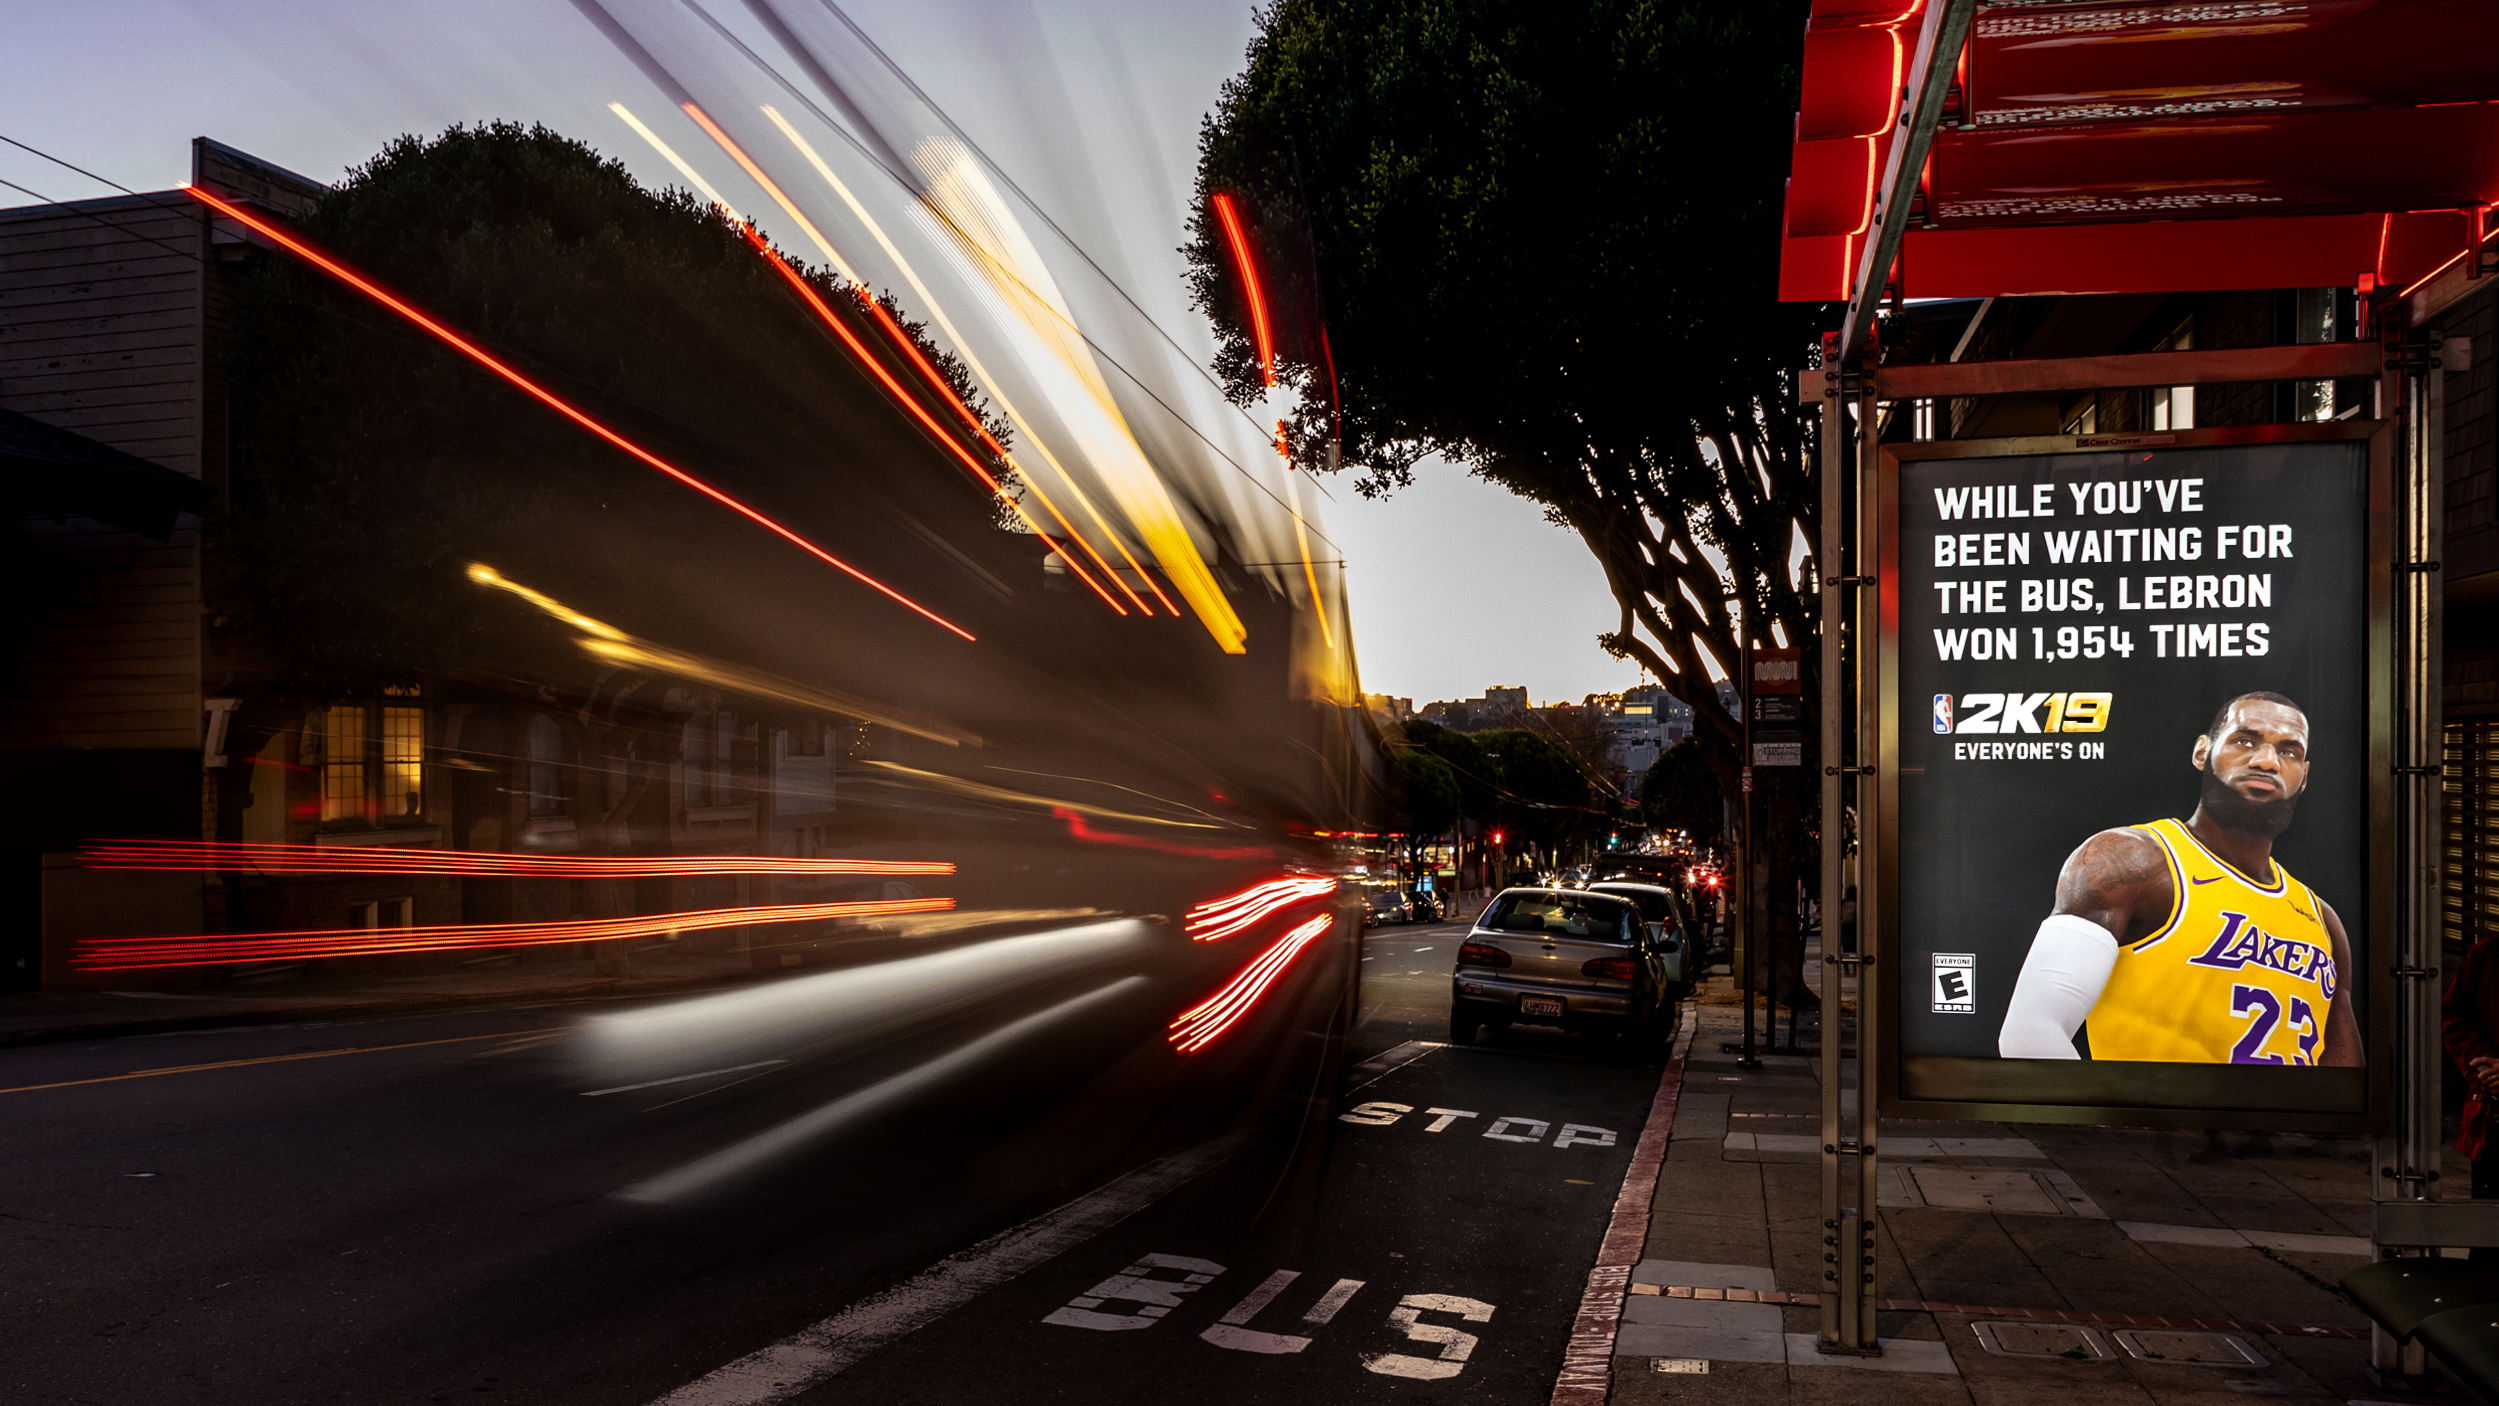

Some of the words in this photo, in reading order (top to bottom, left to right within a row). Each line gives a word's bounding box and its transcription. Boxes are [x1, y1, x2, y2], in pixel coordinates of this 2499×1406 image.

[2110, 437, 2141, 446] Channel
[1934, 484, 2055, 520] WHILE
[2069, 479, 2204, 516] YOU'VE
[1934, 531, 2030, 567] BEEN
[2044, 527, 2202, 563] WAITING
[2217, 525, 2293, 559] FOR
[1934, 580, 2007, 613] THE
[2022, 577, 2105, 614] BUS,
[2119, 574, 2272, 610] LEBRON
[1934, 627, 2017, 660] WON
[2032, 625, 2135, 662] 1,954
[2150, 622, 2270, 658] TIMES
[1754, 697, 1762, 709] 2
[1754, 709, 1762, 720] 3
[1954, 692, 2113, 735] 2K19
[1764, 747, 1800, 755] STOPPING
[1954, 742, 2073, 760] EVERYONE'S
[2079, 742, 2105, 760] ON
[1936, 957, 1971, 966] EVERYONE
[2187, 910, 2337, 1001] LAKERS
[1938, 970, 1969, 1001] E
[1934, 1004, 1973, 1012] ESRB
[2228, 983, 2319, 1066] 23
[1337, 1101, 1617, 1149] STOP
[1591, 1265, 1630, 1287] BUS
[1041, 1251, 1497, 1380] BUS
[1577, 1292, 1624, 1321] STOP
